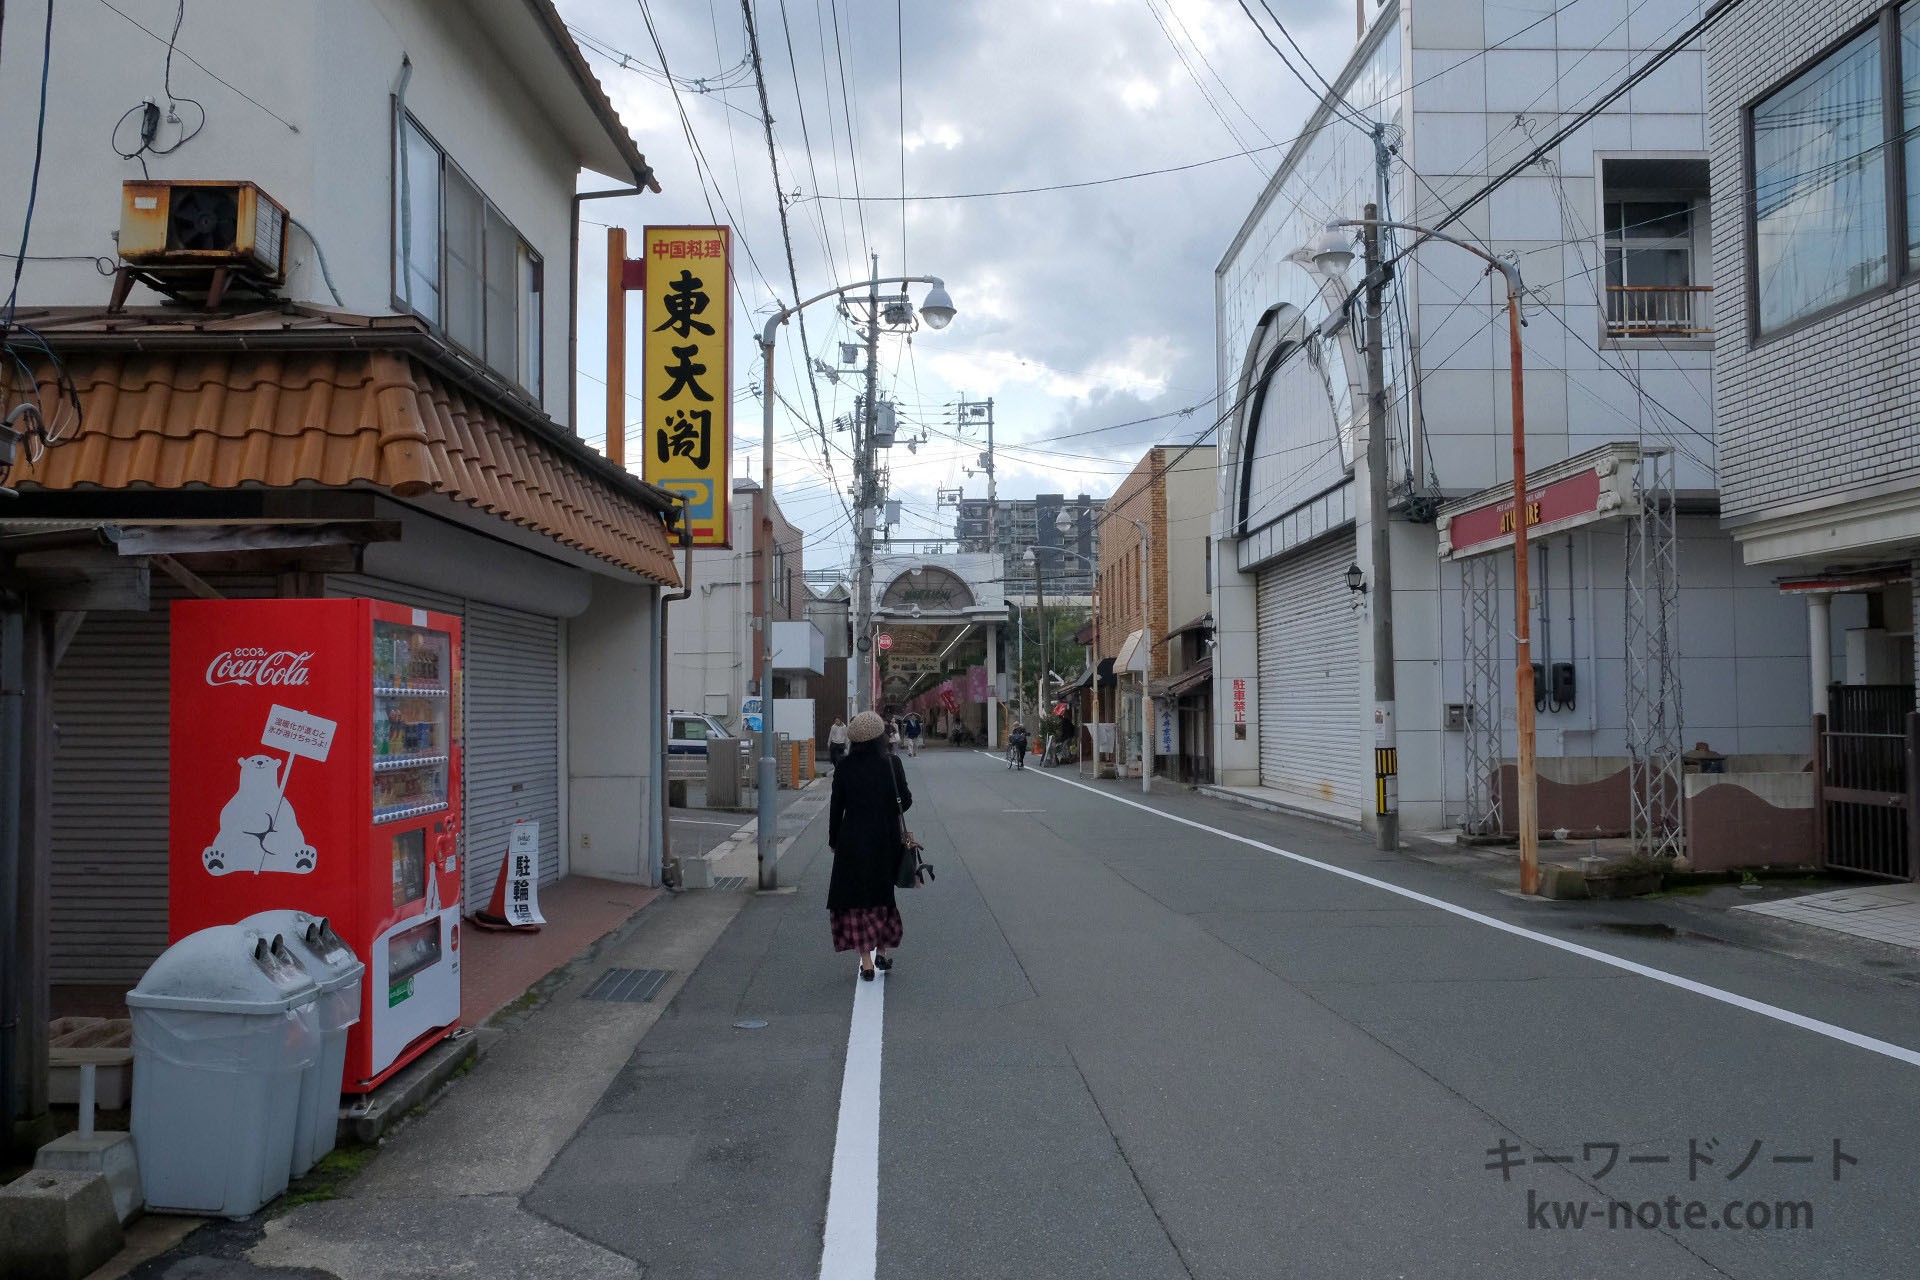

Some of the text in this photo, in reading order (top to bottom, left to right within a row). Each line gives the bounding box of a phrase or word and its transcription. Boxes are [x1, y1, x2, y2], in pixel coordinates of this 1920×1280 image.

[653, 240, 721, 260] 中国料理
[205, 651, 316, 686] Coca-Cola
[1233, 678, 1246, 723] 駐車禁止
[274, 717, 326, 739] 温暖化が進むと
